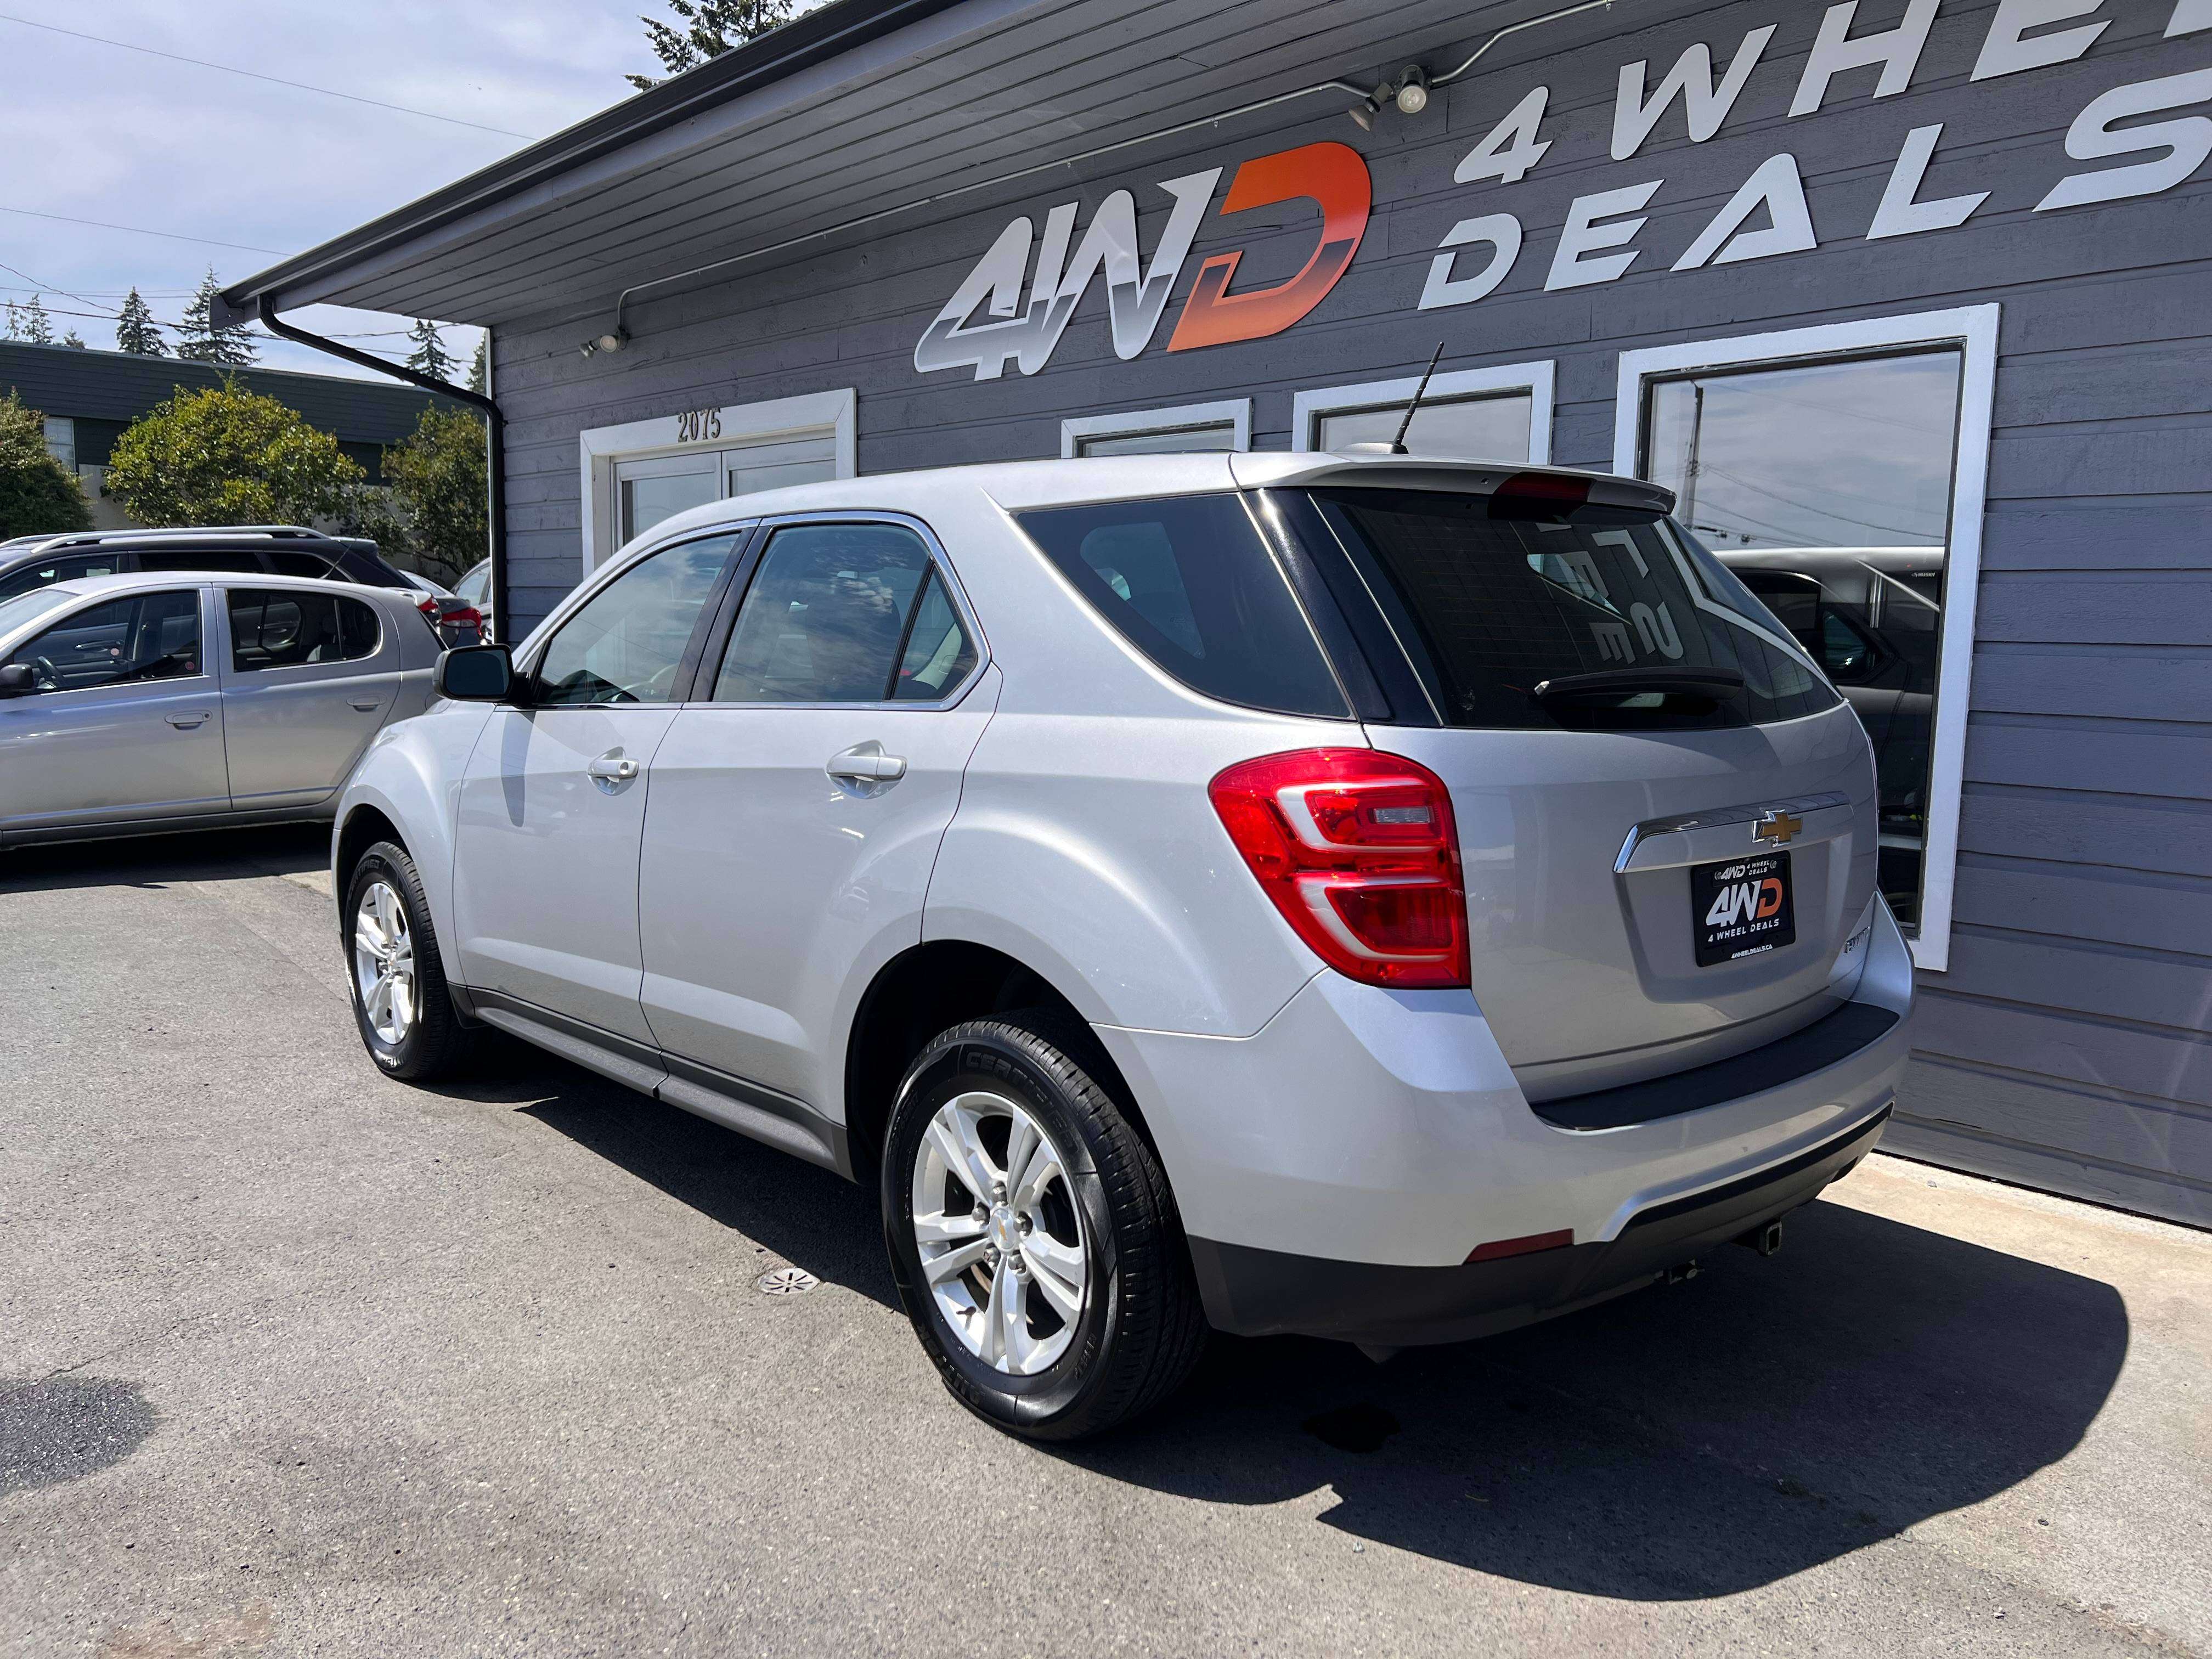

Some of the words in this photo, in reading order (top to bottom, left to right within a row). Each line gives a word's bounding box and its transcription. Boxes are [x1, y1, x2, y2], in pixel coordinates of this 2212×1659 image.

[1453, 85, 1553, 184] 4
[1610, 0, 2212, 161] WHE
[1417, 66, 2212, 311] DEALS
[913, 142, 1373, 382] 4WD
[678, 407, 721, 443] 2075
[1748, 866, 1768, 876] DEALS
[1706, 878, 1782, 927] 4WD
[1707, 934, 1714, 943] 4
[1717, 926, 1746, 940] WHEEL
[1750, 918, 1780, 933] DEALS
[1731, 944, 1773, 959] 4WHEELDEALS.CA
